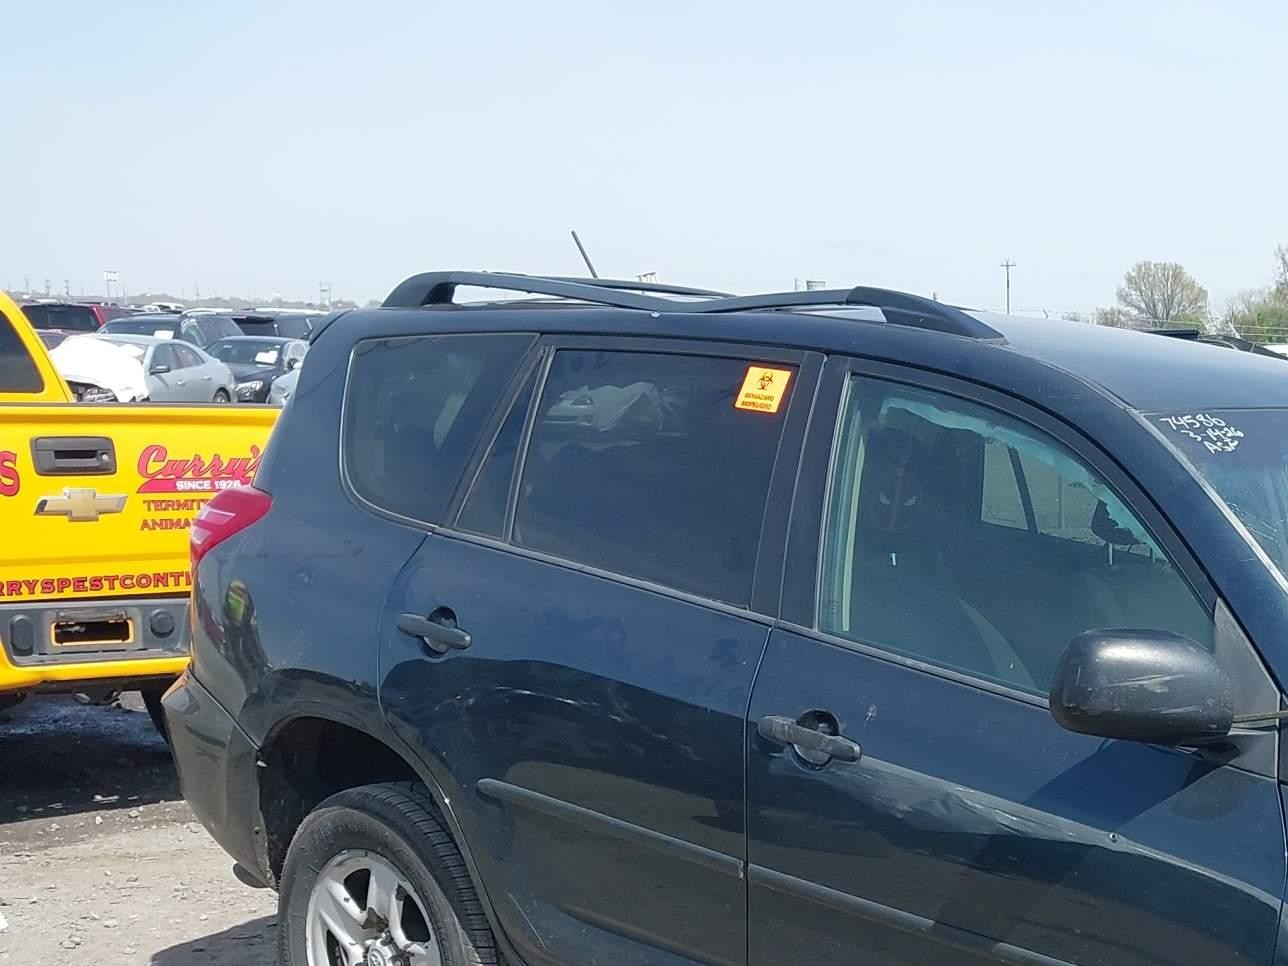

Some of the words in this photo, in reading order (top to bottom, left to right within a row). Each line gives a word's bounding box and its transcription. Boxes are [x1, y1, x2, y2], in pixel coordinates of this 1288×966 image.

[1158, 413, 1226, 430] 74586
[176, 480, 211, 490] SINCE
[214, 480, 241, 489] 1926
